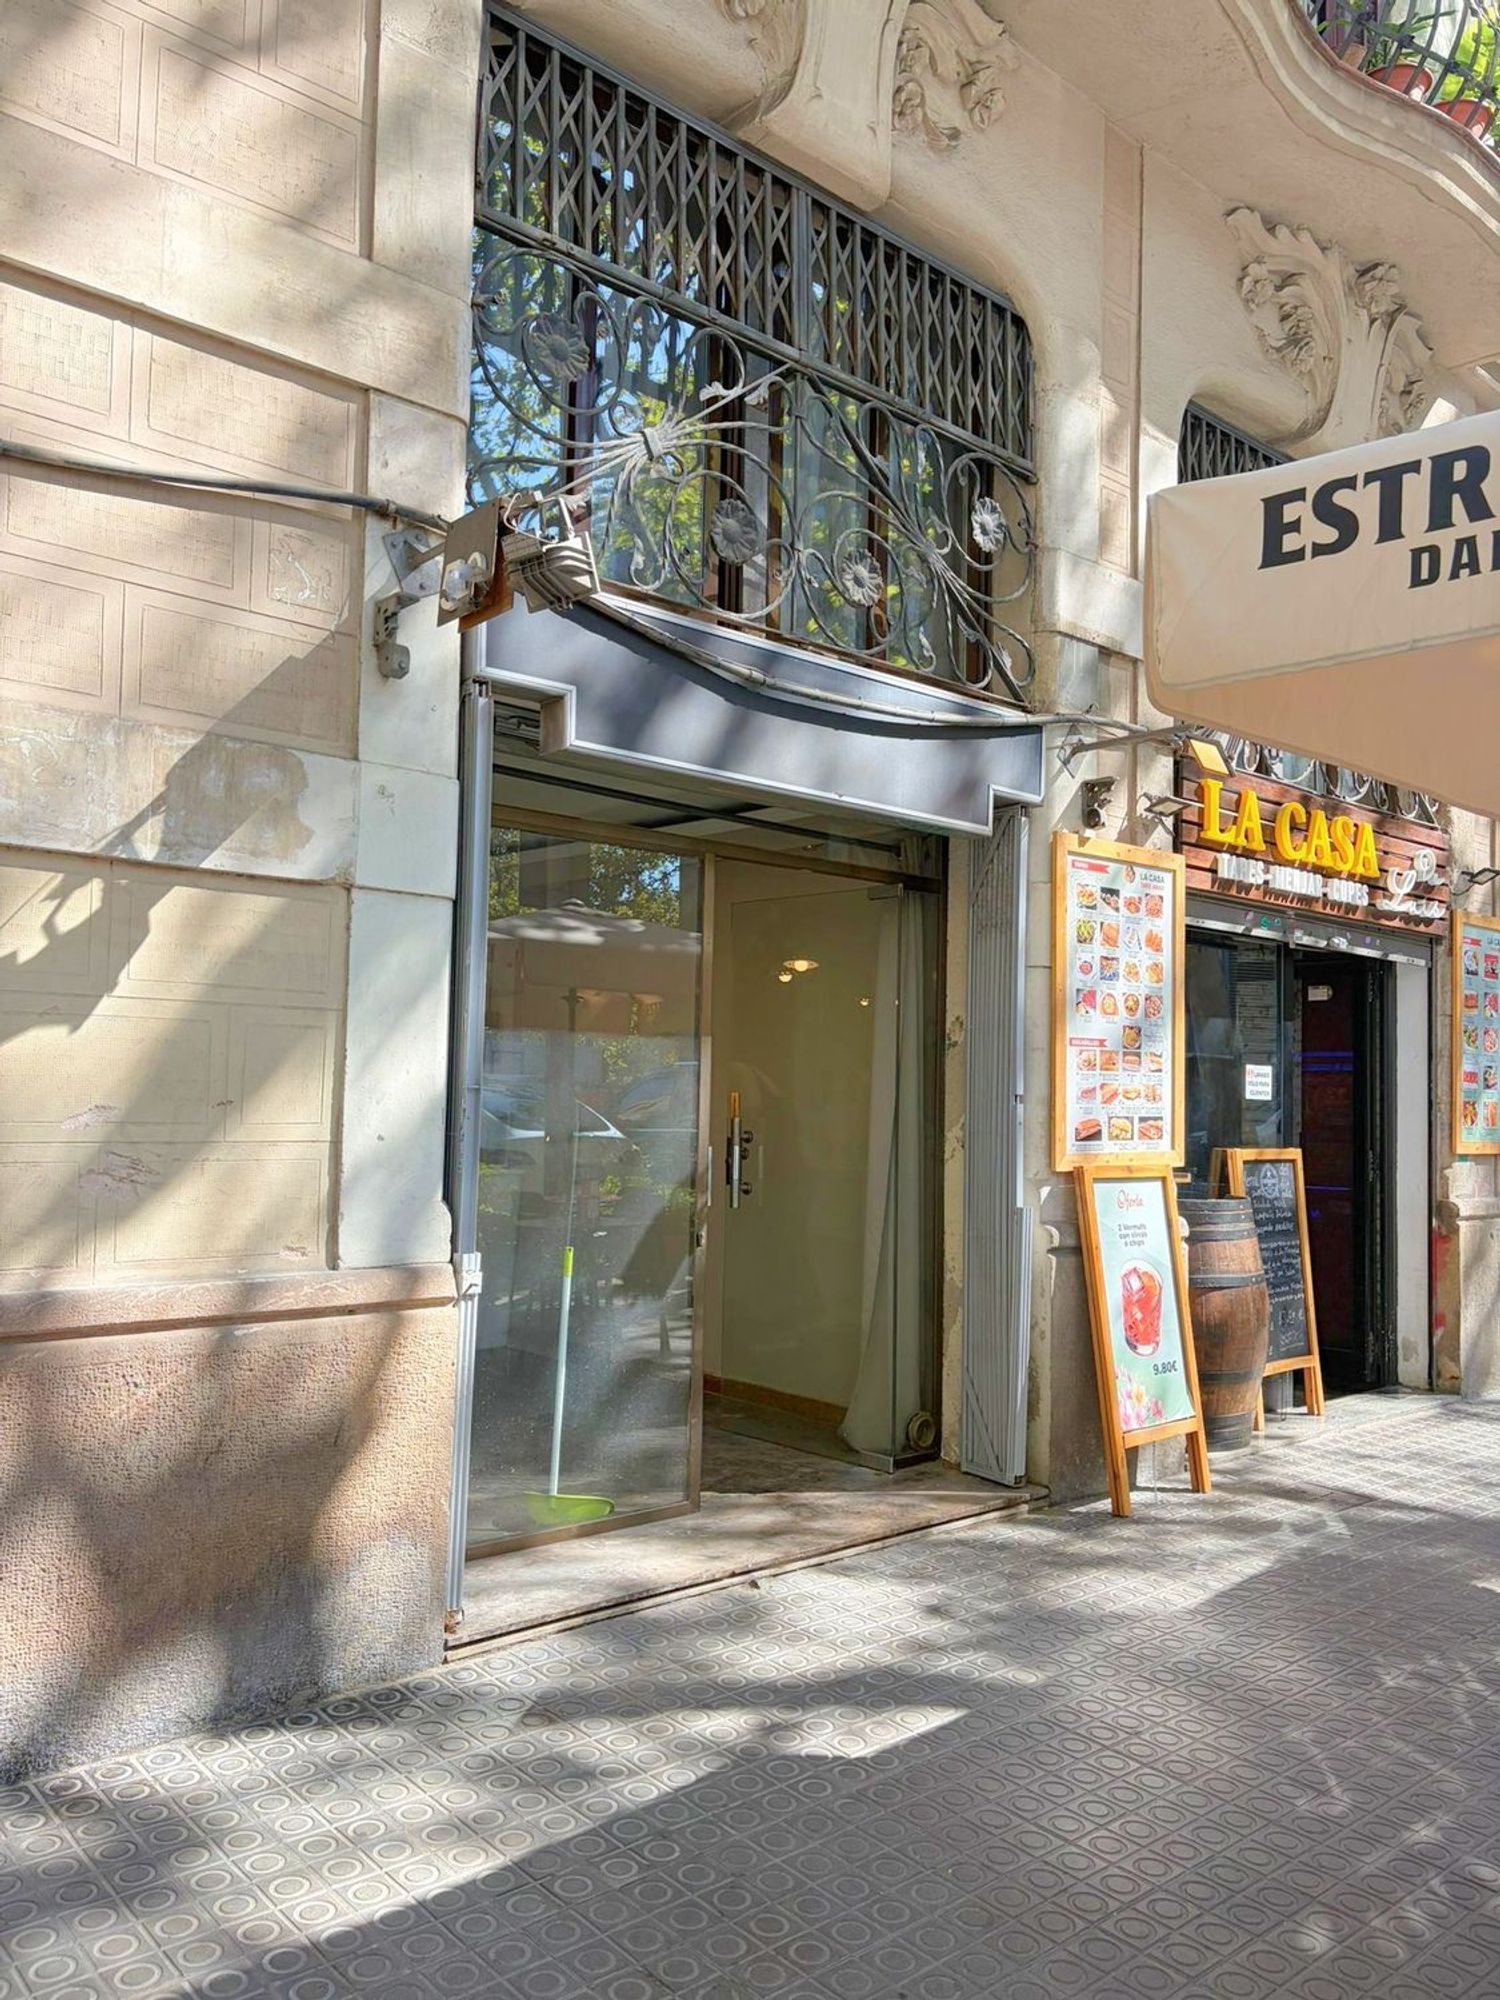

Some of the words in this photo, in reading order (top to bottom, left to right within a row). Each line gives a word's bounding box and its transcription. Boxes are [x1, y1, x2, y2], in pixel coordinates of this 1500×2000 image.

[1408, 530, 1500, 589] DA
[1200, 778, 1266, 852] LA
[1274, 801, 1381, 879] CASA
[1270, 865, 1323, 898] MENJAR
[1328, 878, 1370, 907] COPES
[1153, 1360, 1178, 1376] 9.80€
